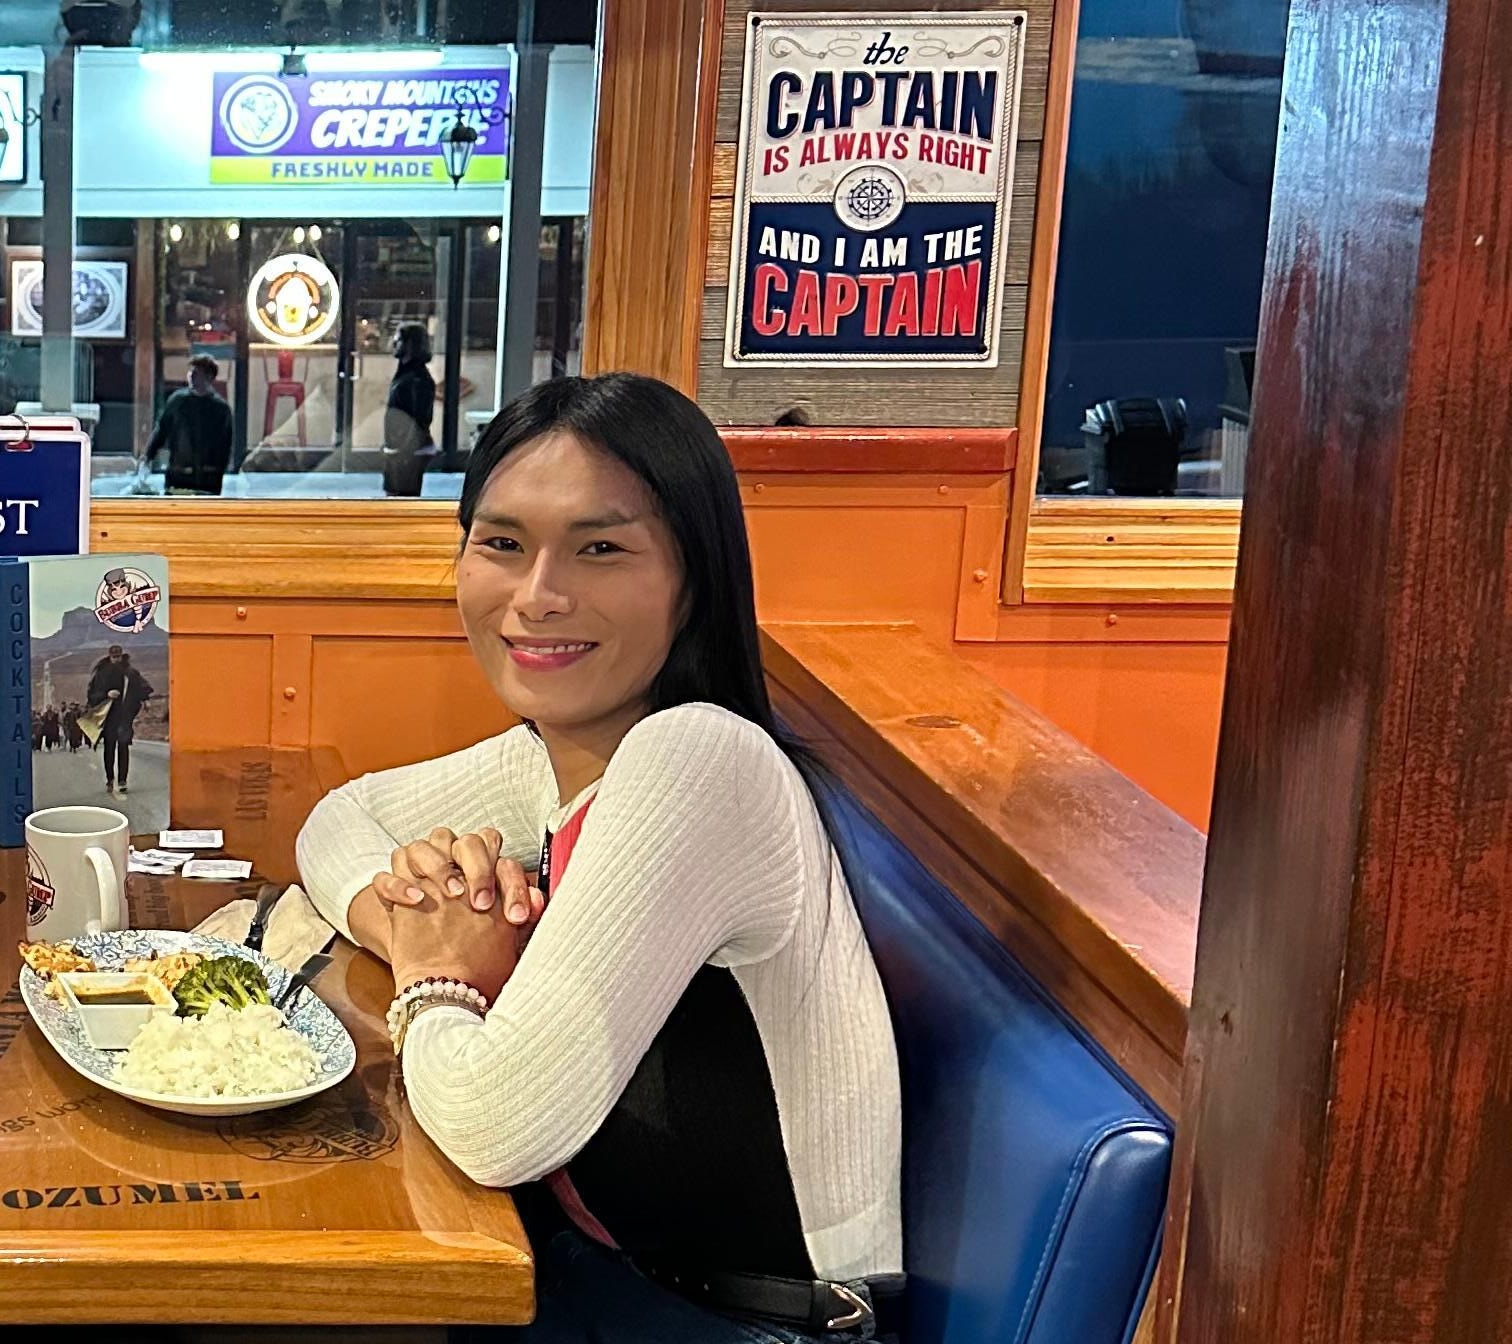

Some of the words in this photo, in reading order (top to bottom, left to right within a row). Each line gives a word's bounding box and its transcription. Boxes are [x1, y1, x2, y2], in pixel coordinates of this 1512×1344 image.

[862, 31, 909, 66] the
[308, 80, 384, 107] SMOKY
[765, 70, 998, 143] CAPTAIN
[270, 161, 367, 178] FRESHLY
[373, 161, 433, 178] MADE
[763, 144, 789, 176] IS
[799, 131, 909, 169] ALWAYS
[919, 133, 992, 175] RIGHT
[759, 226, 820, 264] AND
[834, 237, 846, 267] I
[863, 236, 907, 268] AM
[924, 224, 983, 261] THE
[751, 258, 982, 338] CAPTAIN
[10, 584, 27, 826] COCKTAILS
[35, 1089, 108, 1120] work
